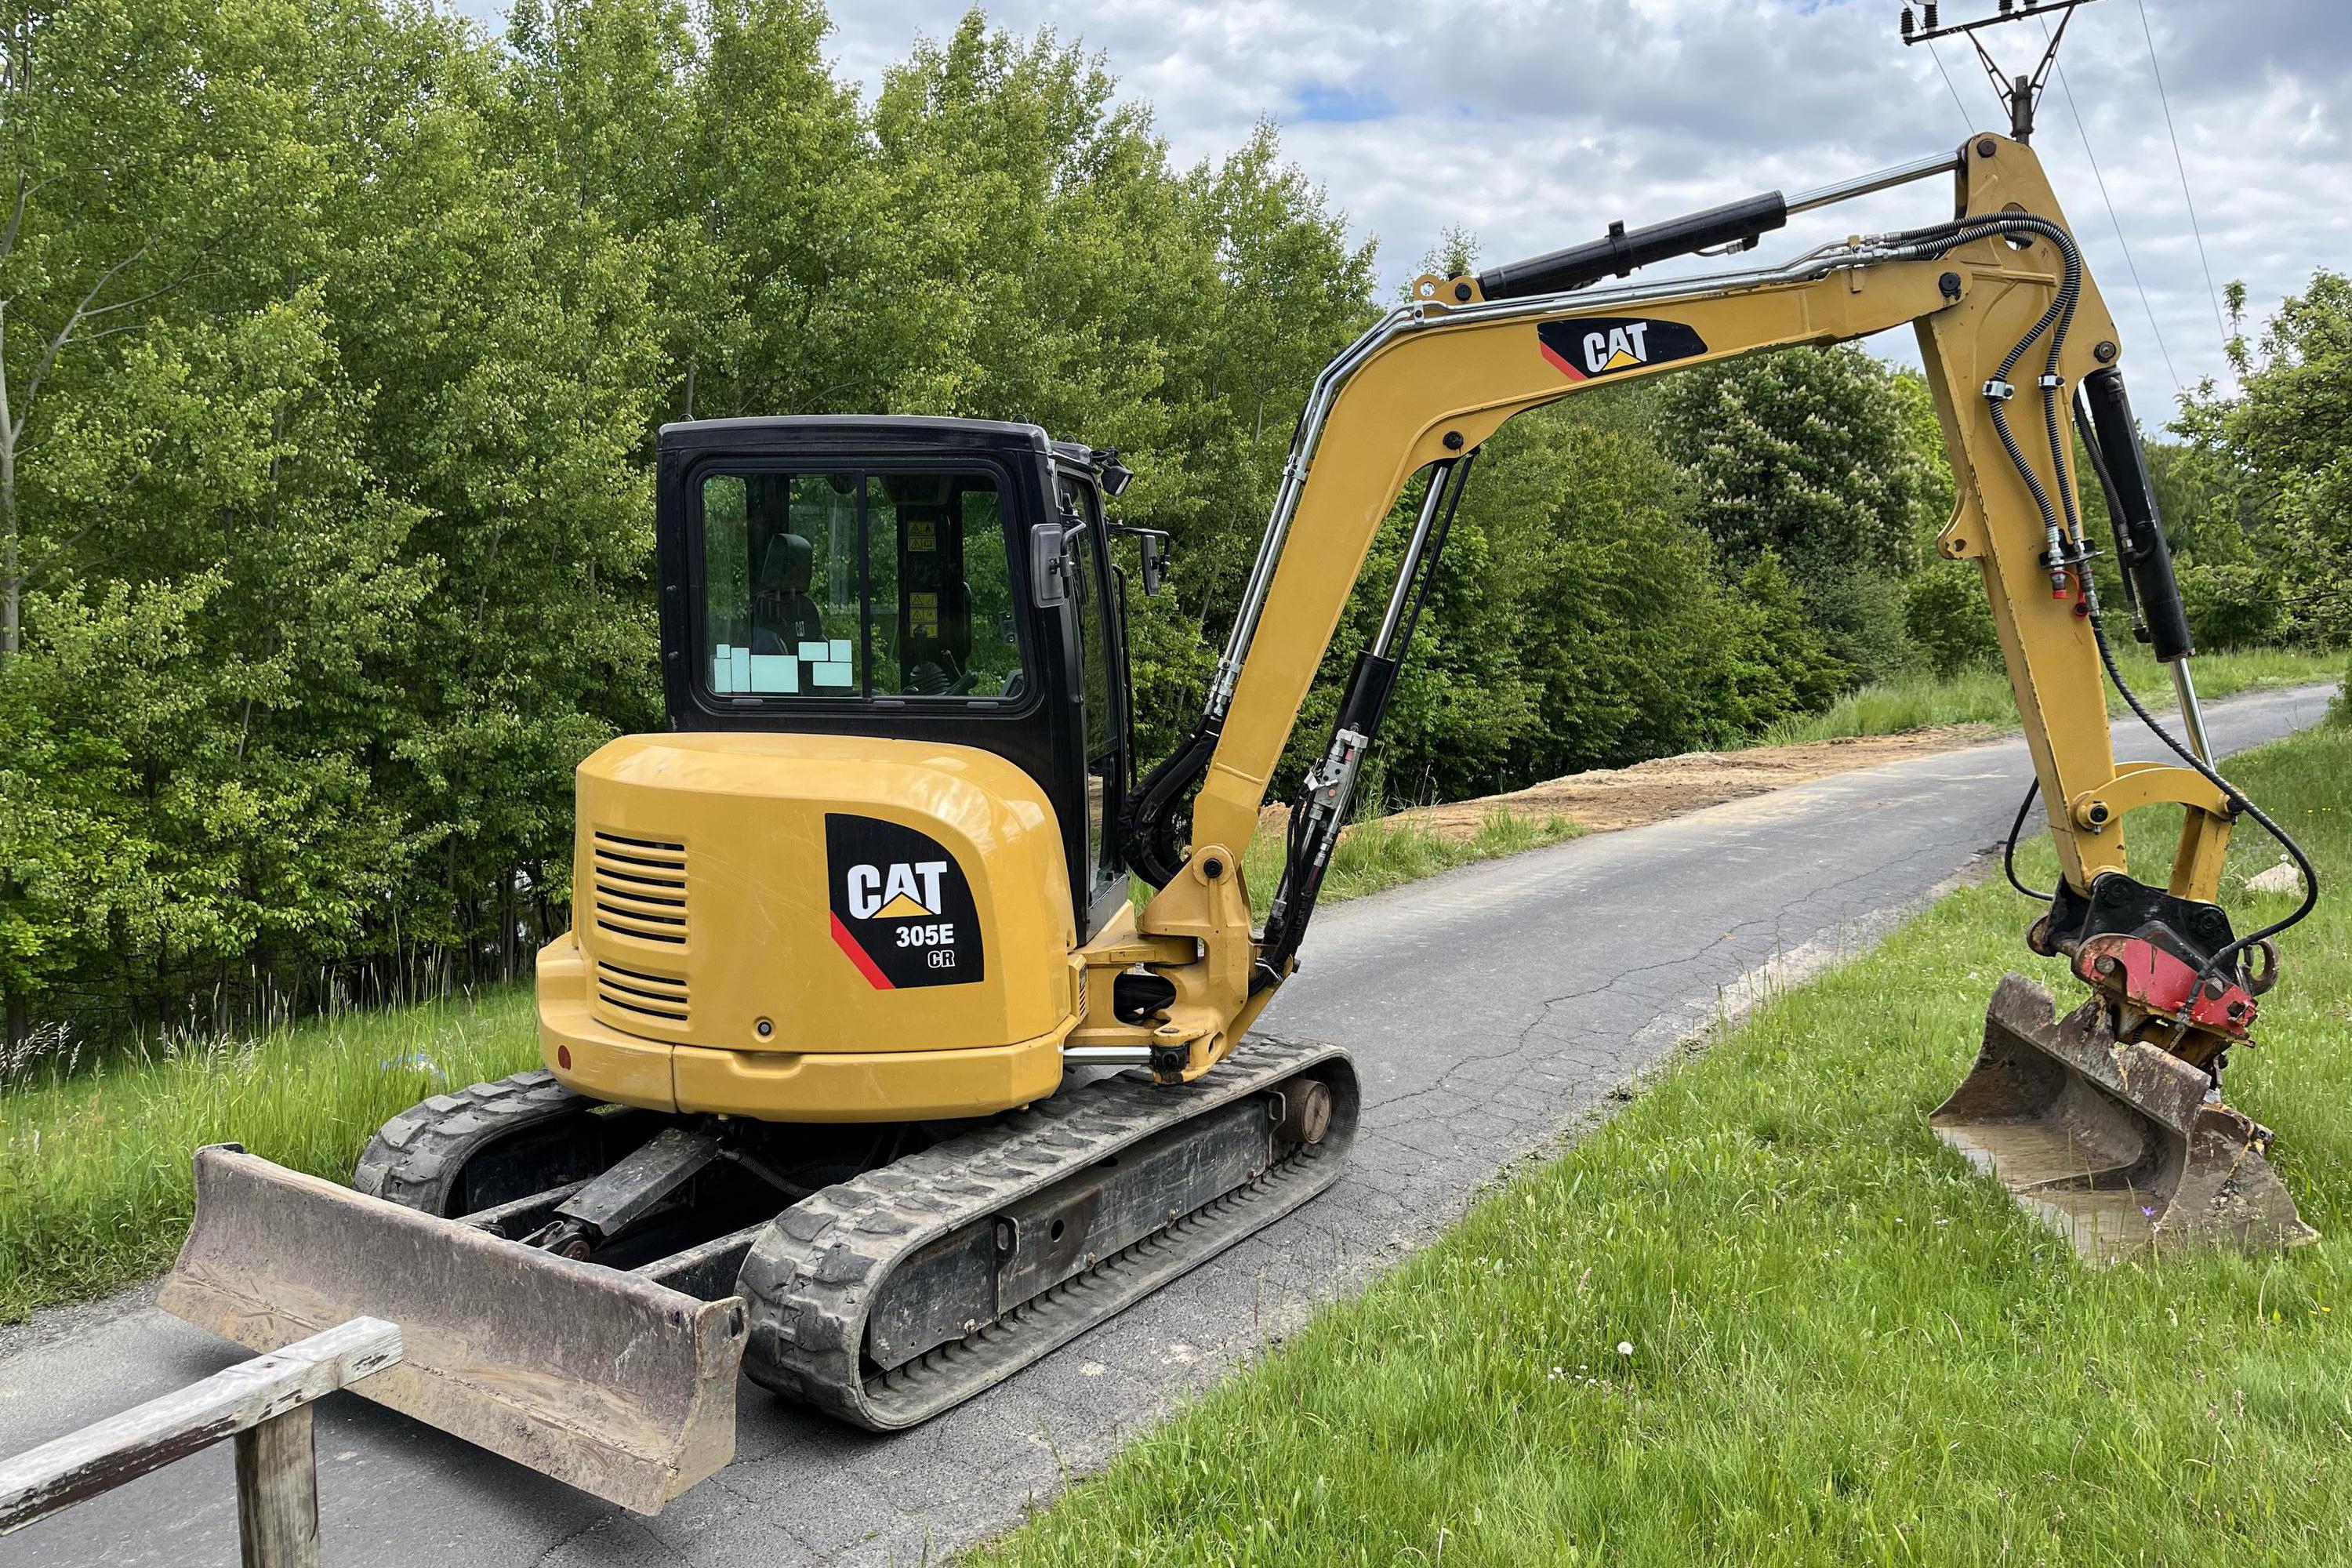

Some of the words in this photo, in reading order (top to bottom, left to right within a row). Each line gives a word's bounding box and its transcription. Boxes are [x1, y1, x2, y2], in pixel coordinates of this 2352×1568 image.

[1583, 321, 1648, 372] CAT
[848, 861, 947, 920] CAT
[895, 924, 955, 948] 305E
[927, 949, 956, 968] CR
